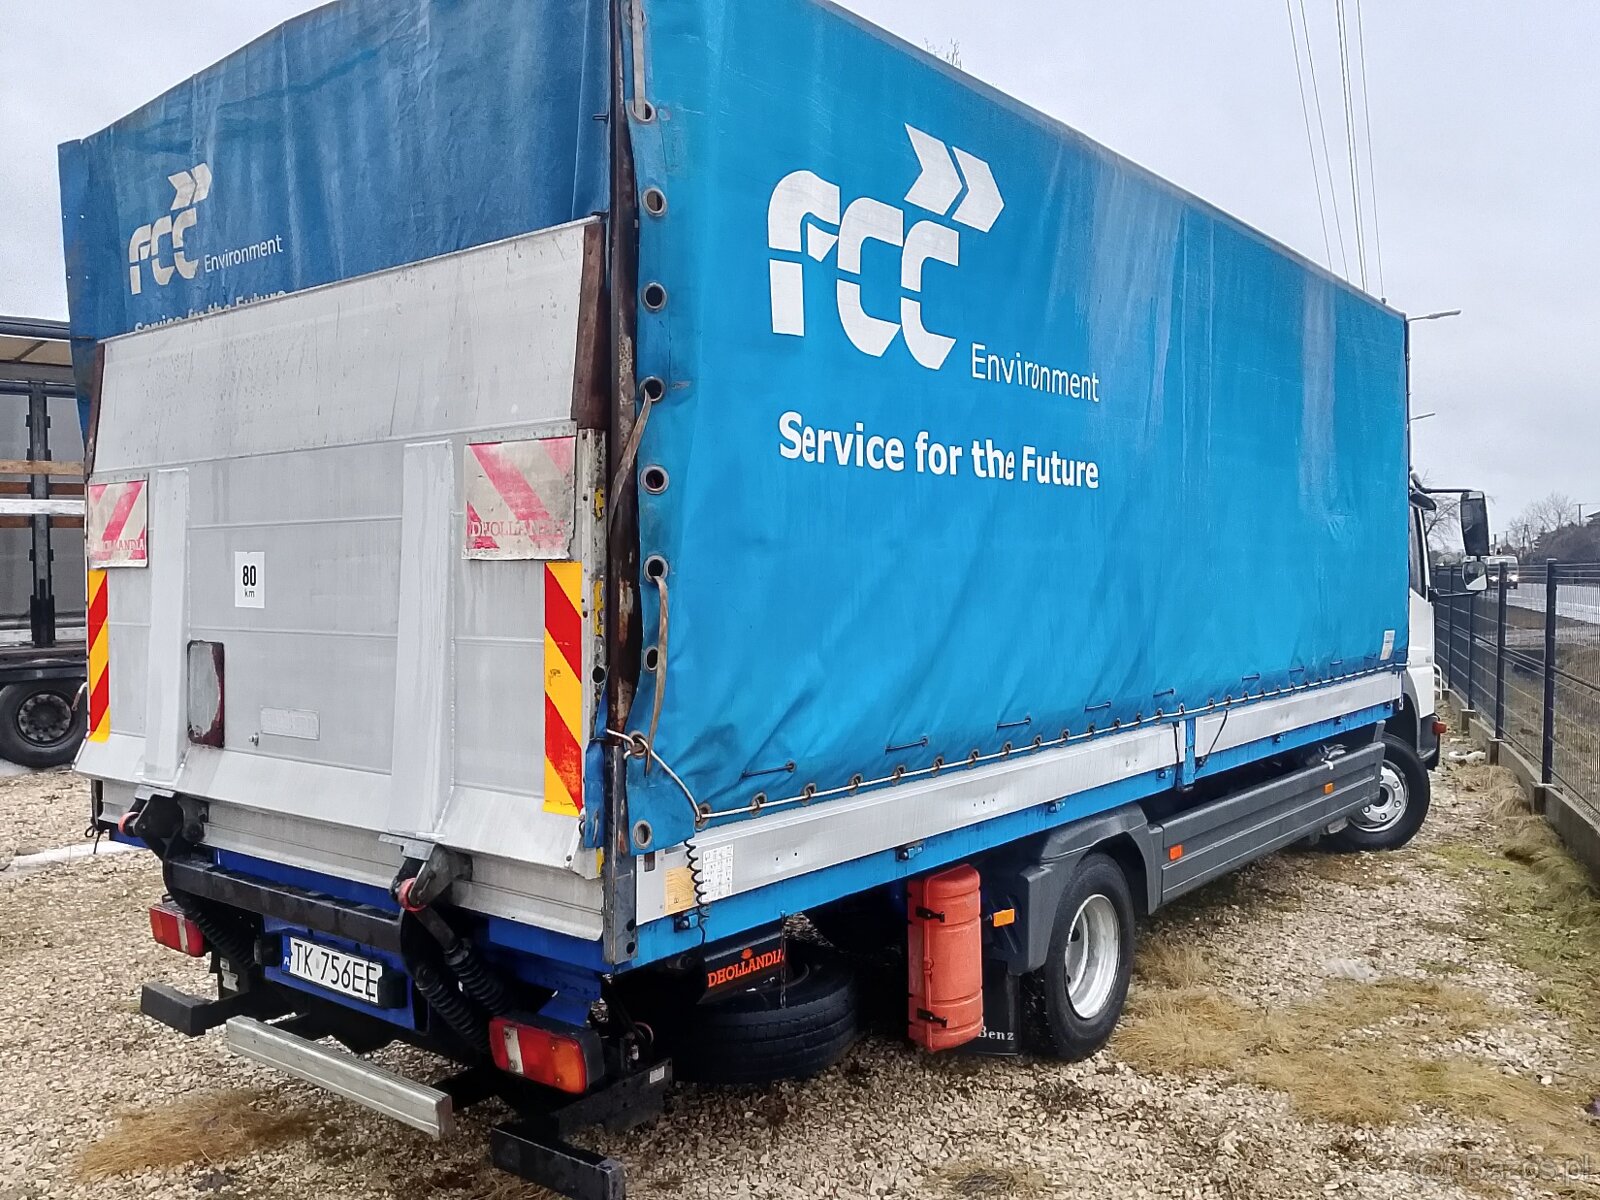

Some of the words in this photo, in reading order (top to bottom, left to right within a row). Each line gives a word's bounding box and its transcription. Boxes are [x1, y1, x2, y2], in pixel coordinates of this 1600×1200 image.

[204, 234, 284, 273] Environment
[971, 342, 1100, 403] Environment
[778, 410, 905, 472] Service
[914, 431, 963, 476] for
[971, 438, 1015, 481] the
[1021, 445, 1100, 489] Future
[242, 564, 257, 587] 80
[244, 588, 255, 598] km
[293, 942, 314, 977] TK
[320, 951, 378, 998] 756EE
[707, 948, 784, 988] DHOLLANDIA
